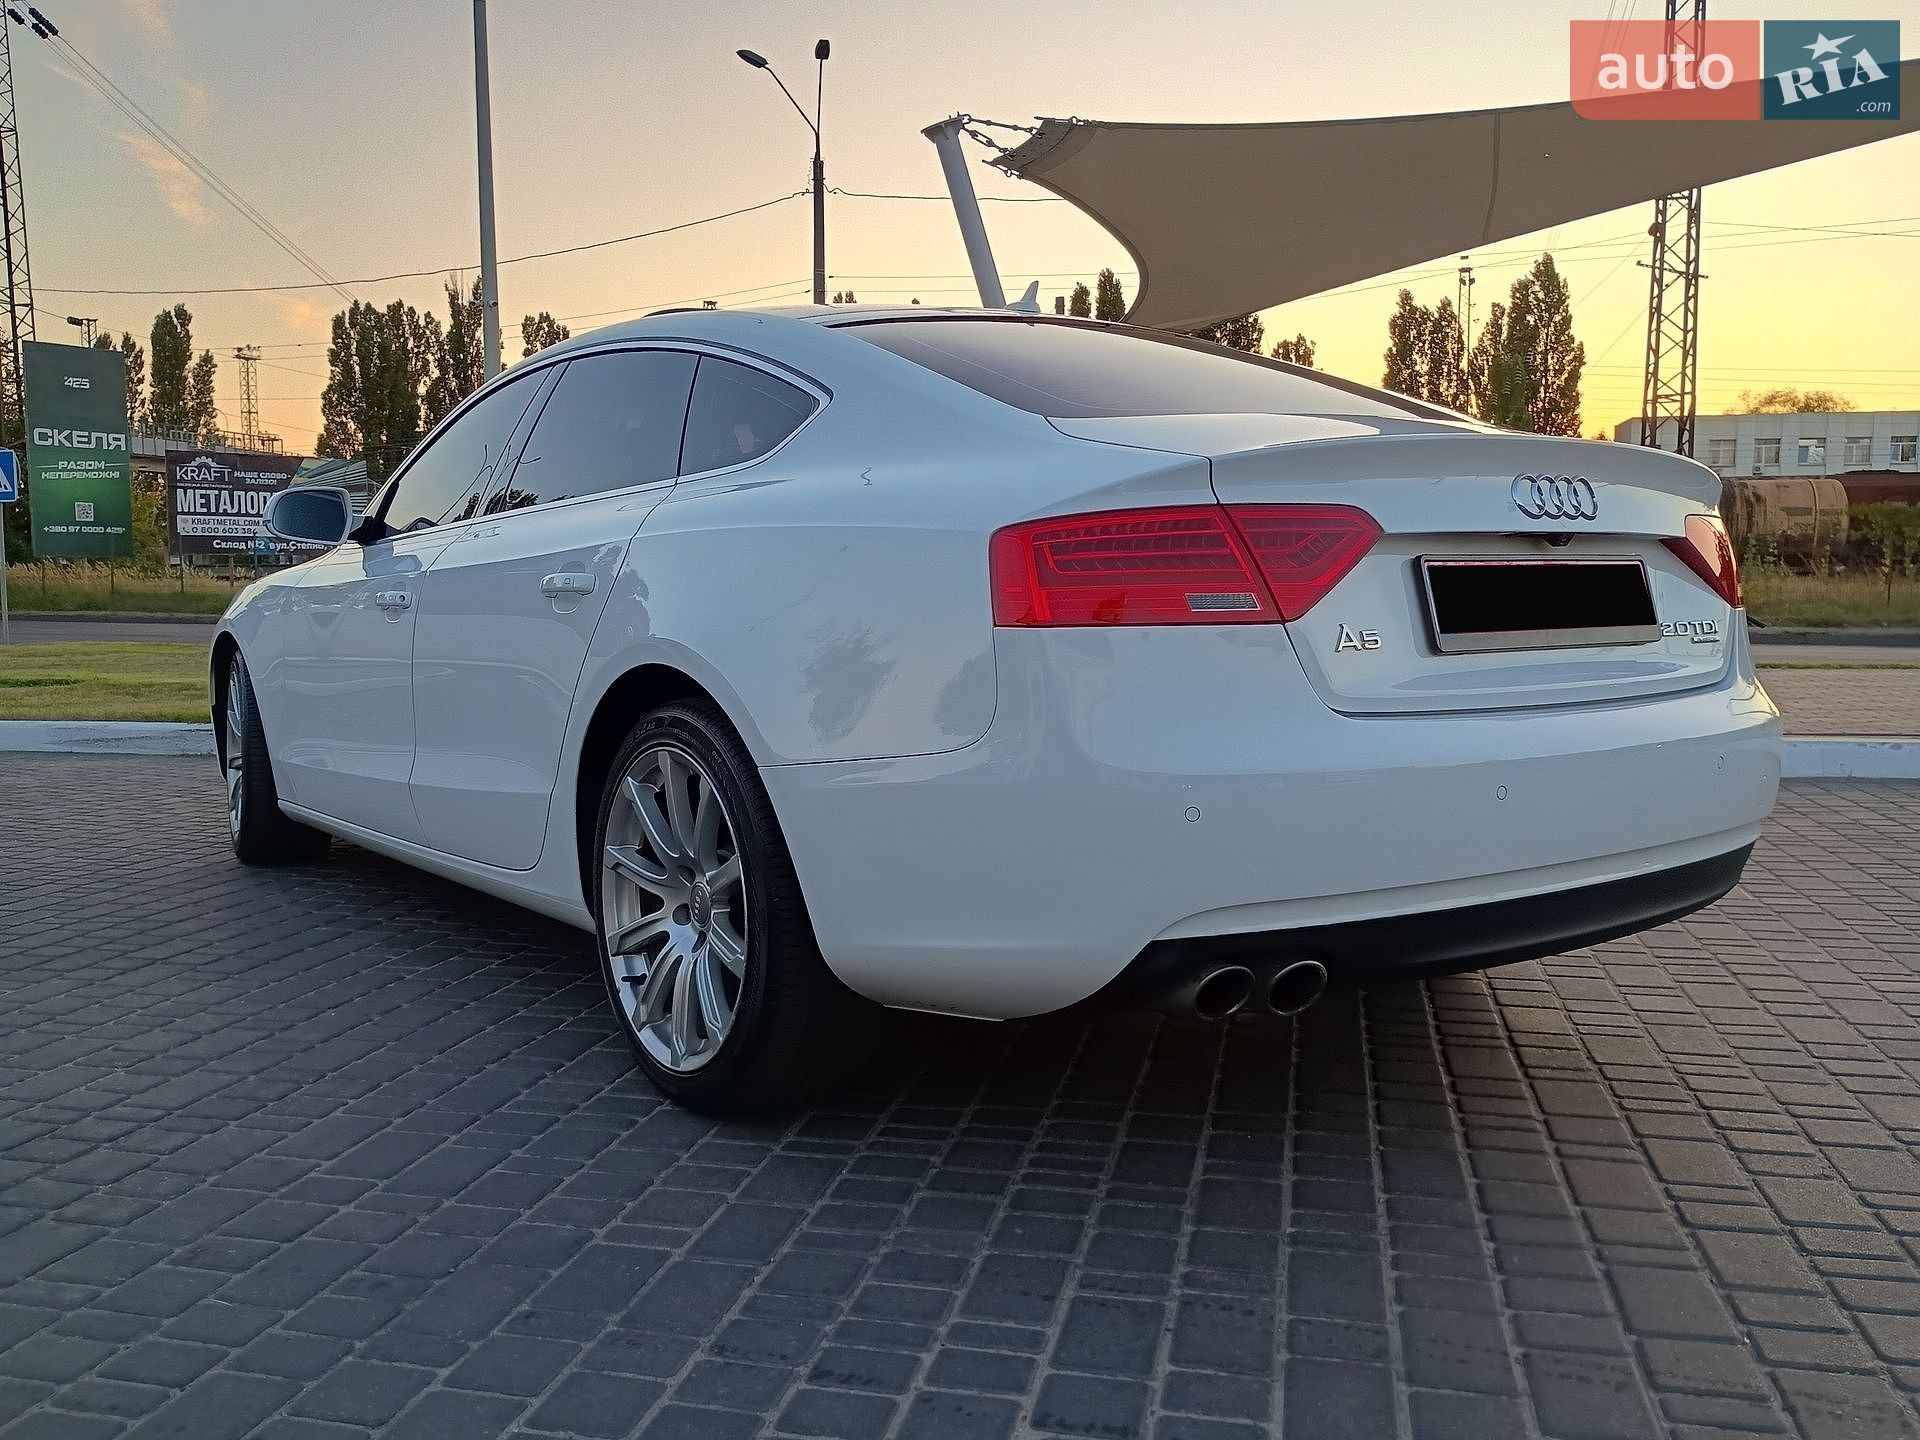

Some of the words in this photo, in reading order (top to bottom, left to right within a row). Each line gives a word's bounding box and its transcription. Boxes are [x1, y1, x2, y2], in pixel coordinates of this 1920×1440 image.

[33, 427, 126, 451] СКЕЛЯ
[58, 460, 105, 470] РАЗОМ
[41, 471, 120, 480] НЕПЕРЕМОЖНІ
[176, 466, 232, 482] KRAFT
[234, 470, 259, 479] НАШЕ
[245, 478, 277, 486] ЗАЛІЗО!
[176, 488, 274, 515] МЕТАЛОП
[43, 525, 68, 534] +380
[68, 525, 80, 534] 97
[191, 526, 198, 534] 0
[200, 526, 219, 534] 800
[221, 527, 239, 535] 603
[213, 539, 246, 550] Склад
[1335, 623, 1381, 653] A5
